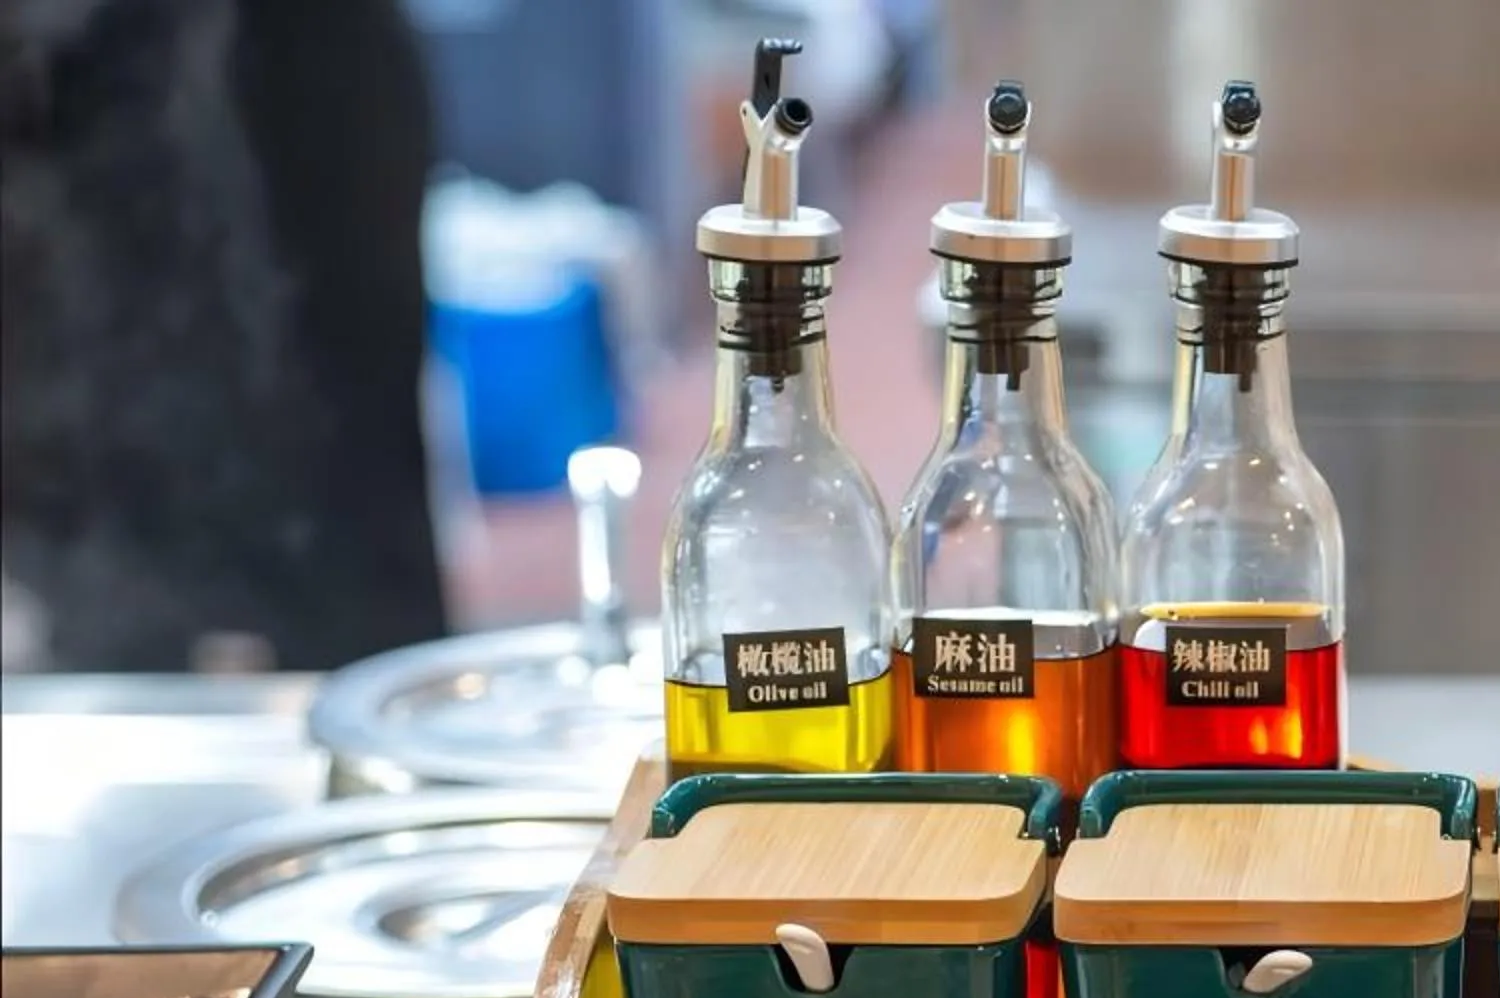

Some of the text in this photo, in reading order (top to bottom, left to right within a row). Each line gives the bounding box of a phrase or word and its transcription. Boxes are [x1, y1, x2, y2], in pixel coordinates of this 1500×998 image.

[737, 640, 836, 678] 橄榄油
[934, 630, 1016, 673] 麻油
[1173, 639, 1271, 673] 辣椒油
[748, 681, 828, 702] Olive oil
[927, 675, 1024, 693] Sesame oil
[1181, 680, 1260, 698] Chili oil
